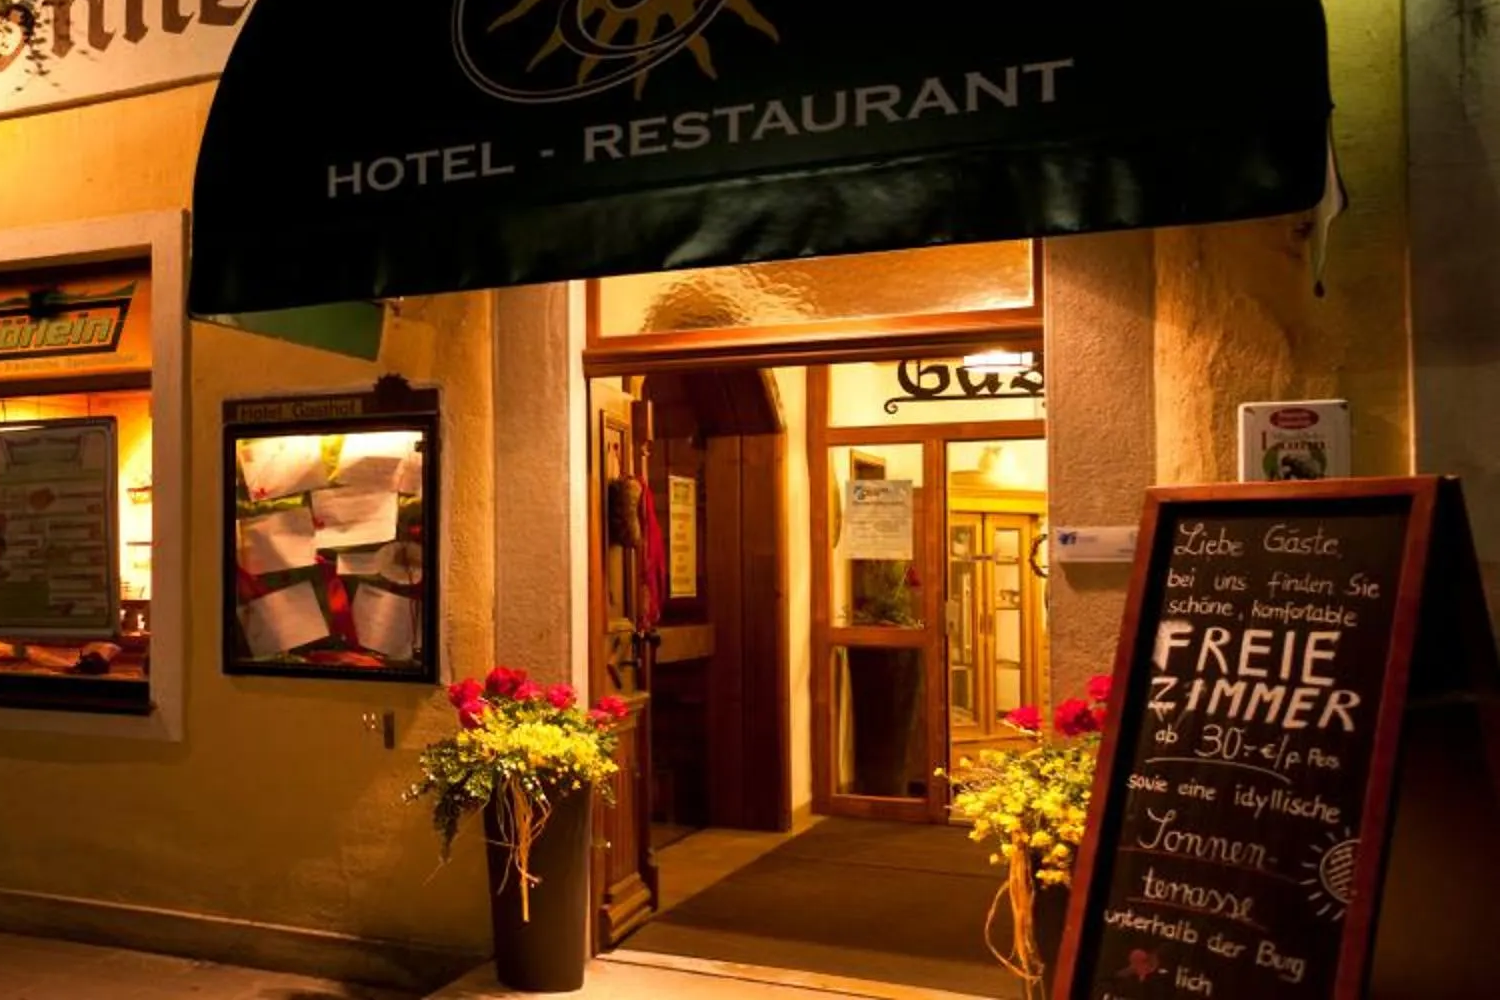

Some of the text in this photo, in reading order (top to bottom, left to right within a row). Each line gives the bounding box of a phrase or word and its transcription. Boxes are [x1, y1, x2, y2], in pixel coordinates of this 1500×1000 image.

[327, 140, 515, 199] HOTEL
[584, 57, 1075, 163] RESTAURANT
[1173, 522, 1246, 557] Liebe
[1166, 567, 1381, 598] bei uns finden Sie
[1251, 599, 1359, 627] komfortable
[1151, 619, 1342, 687] FREIE
[1147, 676, 1362, 732] ZIMMER
[1155, 724, 1180, 744] ab
[1126, 773, 1341, 824] sowie eine idyllische
[1103, 907, 1307, 984] unterhalb der Burg
